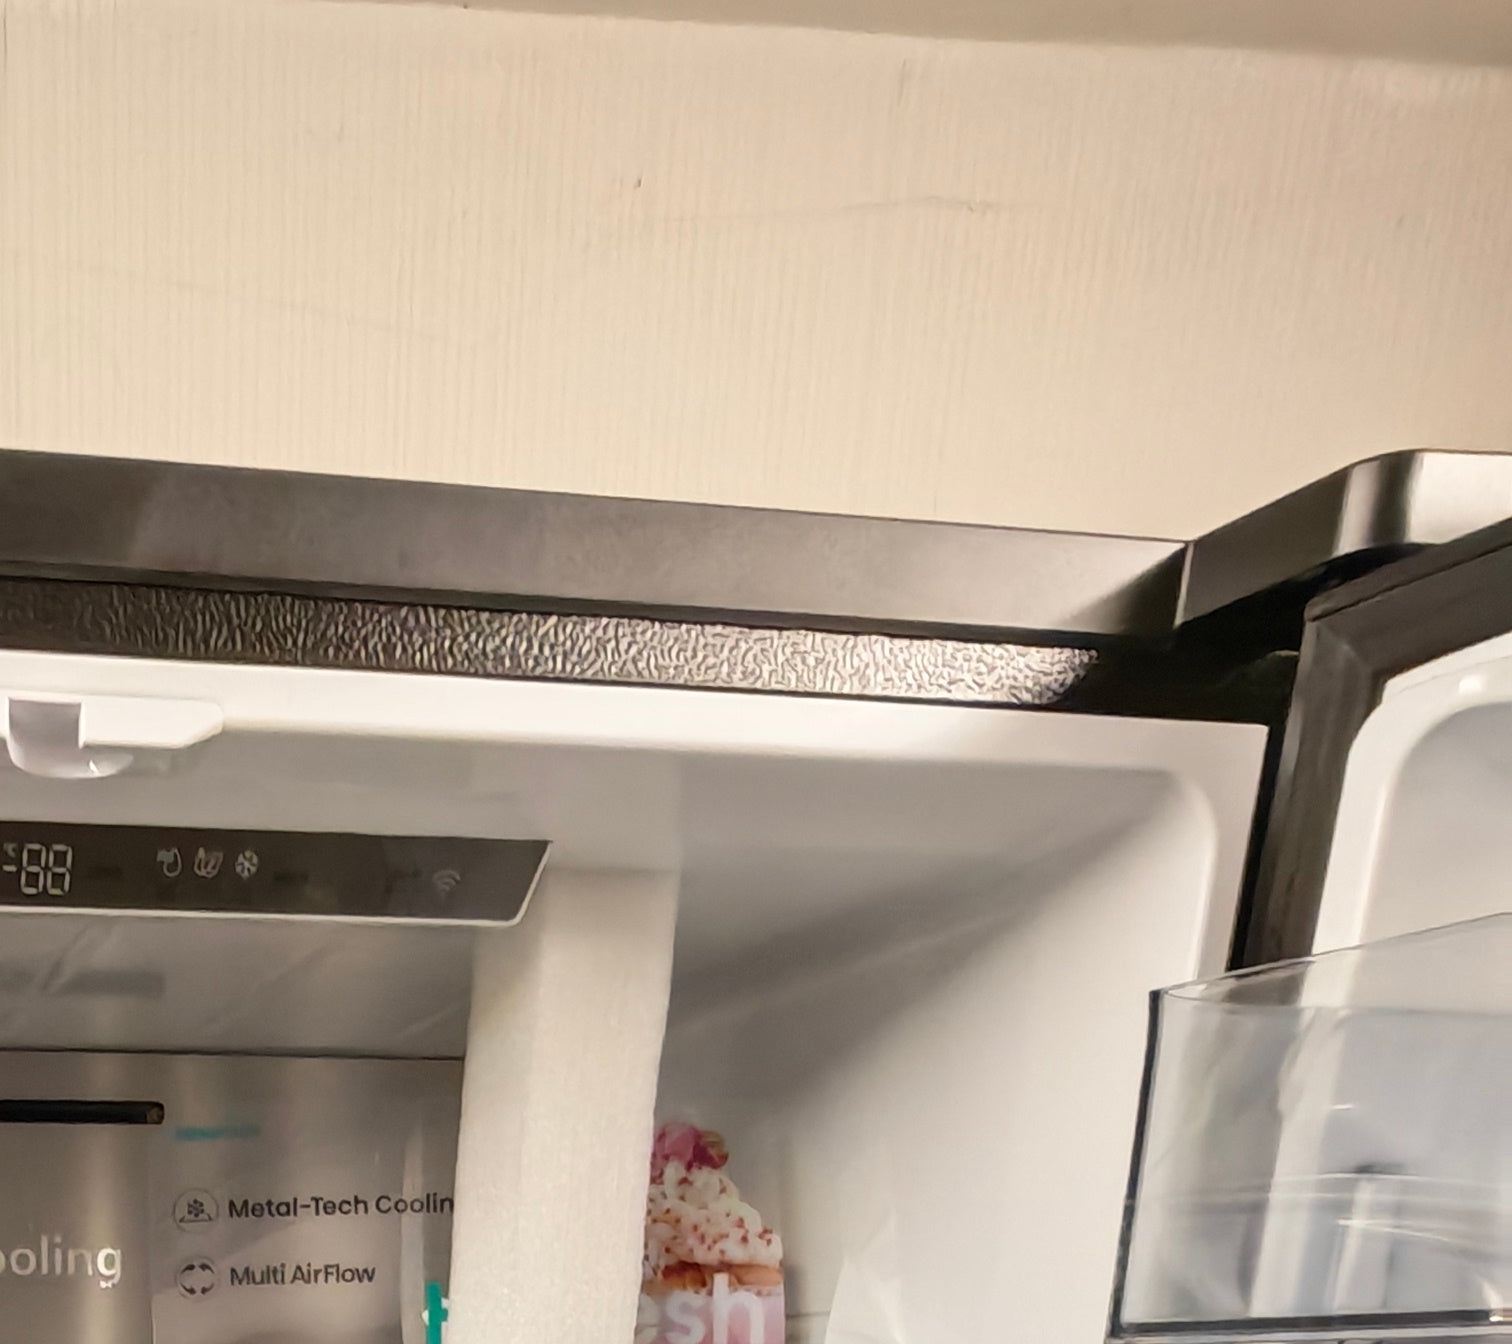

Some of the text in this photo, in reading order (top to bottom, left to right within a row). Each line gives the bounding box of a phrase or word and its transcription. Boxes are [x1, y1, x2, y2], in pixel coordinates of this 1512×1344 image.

[228, 1192, 454, 1219] Metal-Tech Coolin
[230, 1264, 286, 1286] Multi
